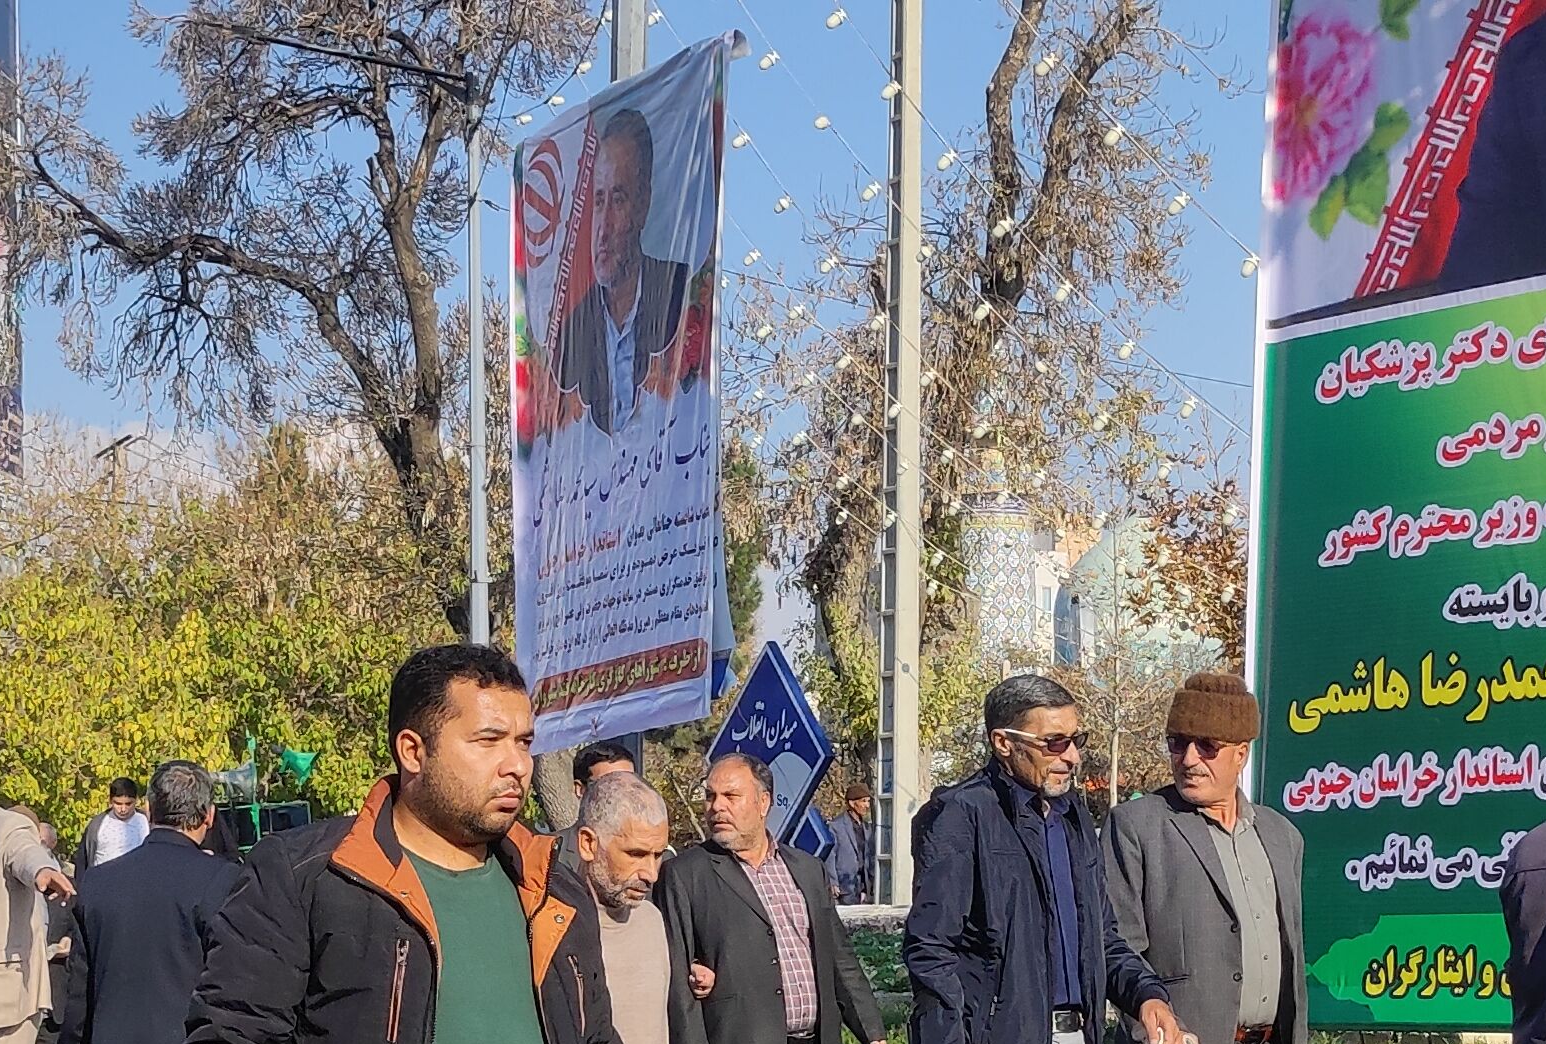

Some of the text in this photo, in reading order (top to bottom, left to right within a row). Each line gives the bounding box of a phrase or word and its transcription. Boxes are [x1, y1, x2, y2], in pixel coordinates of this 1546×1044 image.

[1319, 344, 1433, 398] پزشکیان
[1439, 326, 1509, 379] دکتر
[1440, 418, 1542, 462] مردمی
[1322, 512, 1387, 562] کشور
[1392, 510, 1472, 555] محترم
[1478, 502, 1538, 544] وزیر
[1448, 576, 1533, 623] بایسته
[1287, 656, 1411, 734] هاشمی
[731, 700, 798, 753] میدان انقلاب
[1288, 766, 1352, 808] جنوبی
[1358, 753, 1438, 801] خراسان
[1446, 751, 1533, 800] استاندار
[1436, 857, 1473, 883] می
[1364, 946, 1474, 997] ایثارگران
[1476, 967, 1492, 997] و
